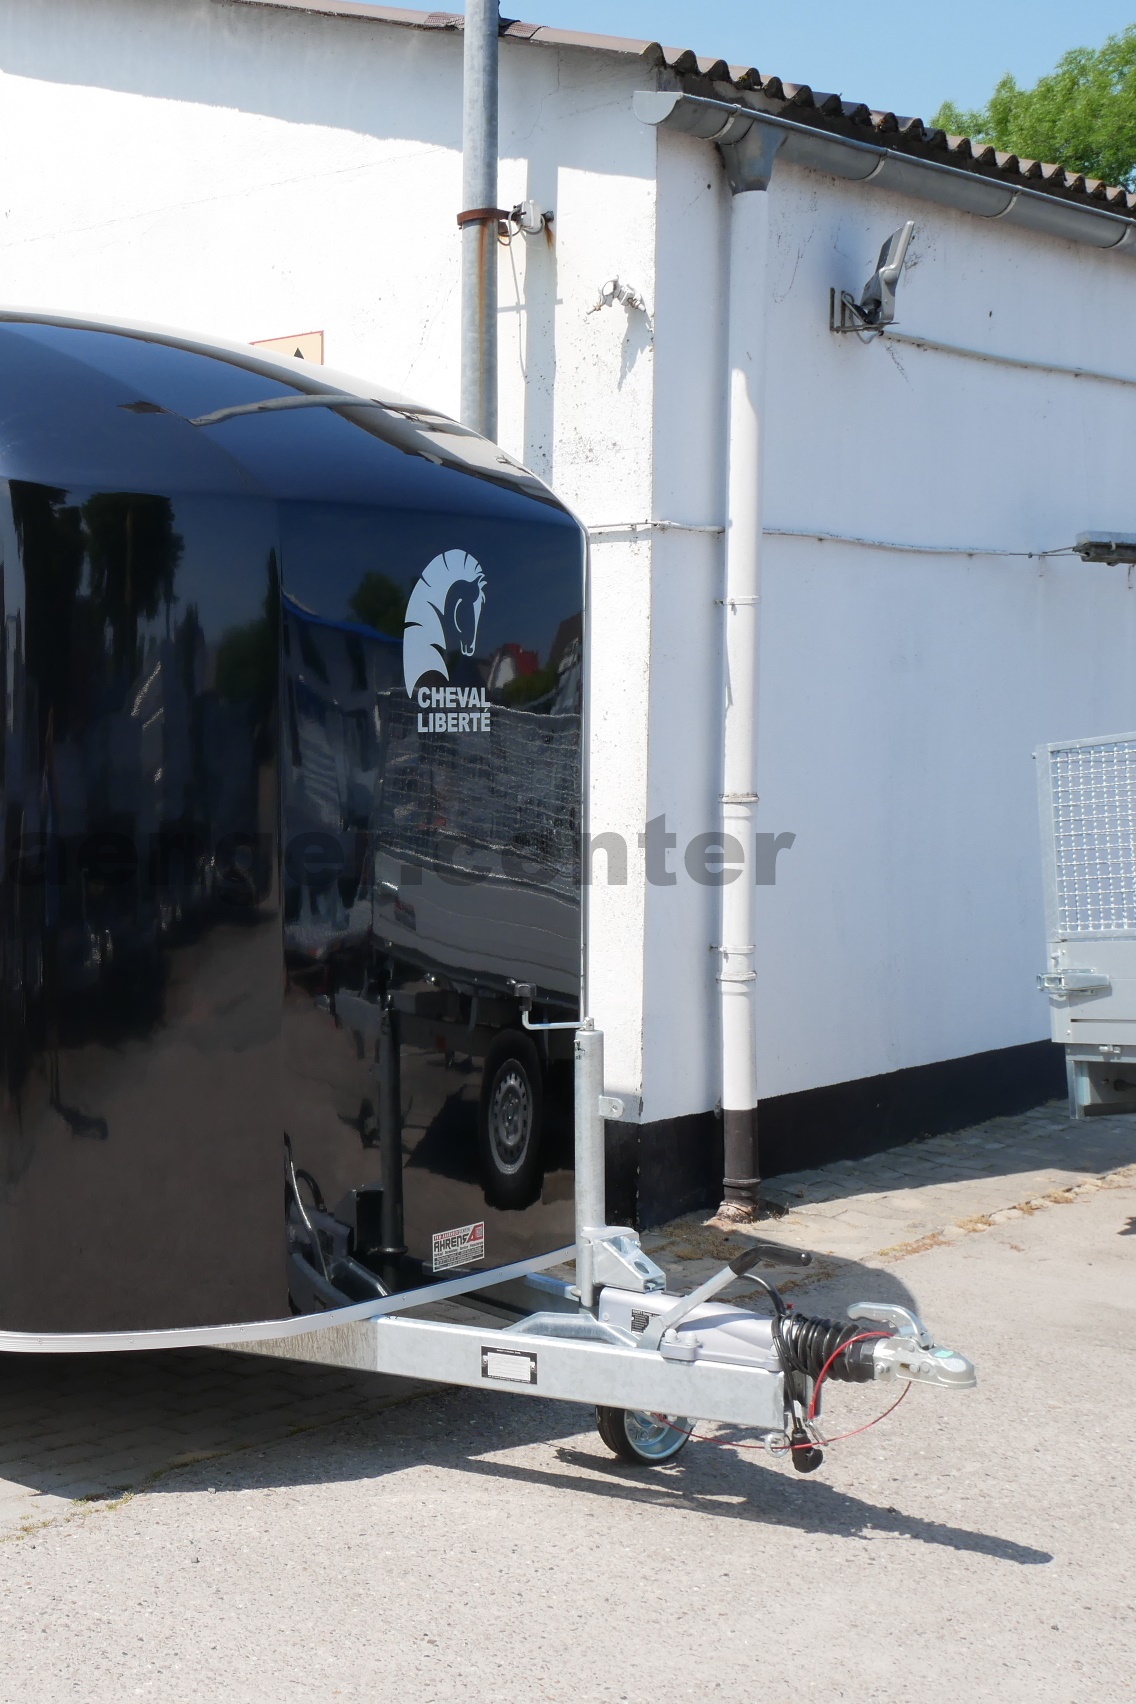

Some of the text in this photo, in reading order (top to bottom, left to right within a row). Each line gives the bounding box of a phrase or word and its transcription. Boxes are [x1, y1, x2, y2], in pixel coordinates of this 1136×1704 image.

[417, 686, 491, 708] CHEVAL
[417, 707, 491, 733] LIBERTÉ
[434, 1232, 470, 1253] AHRENS
